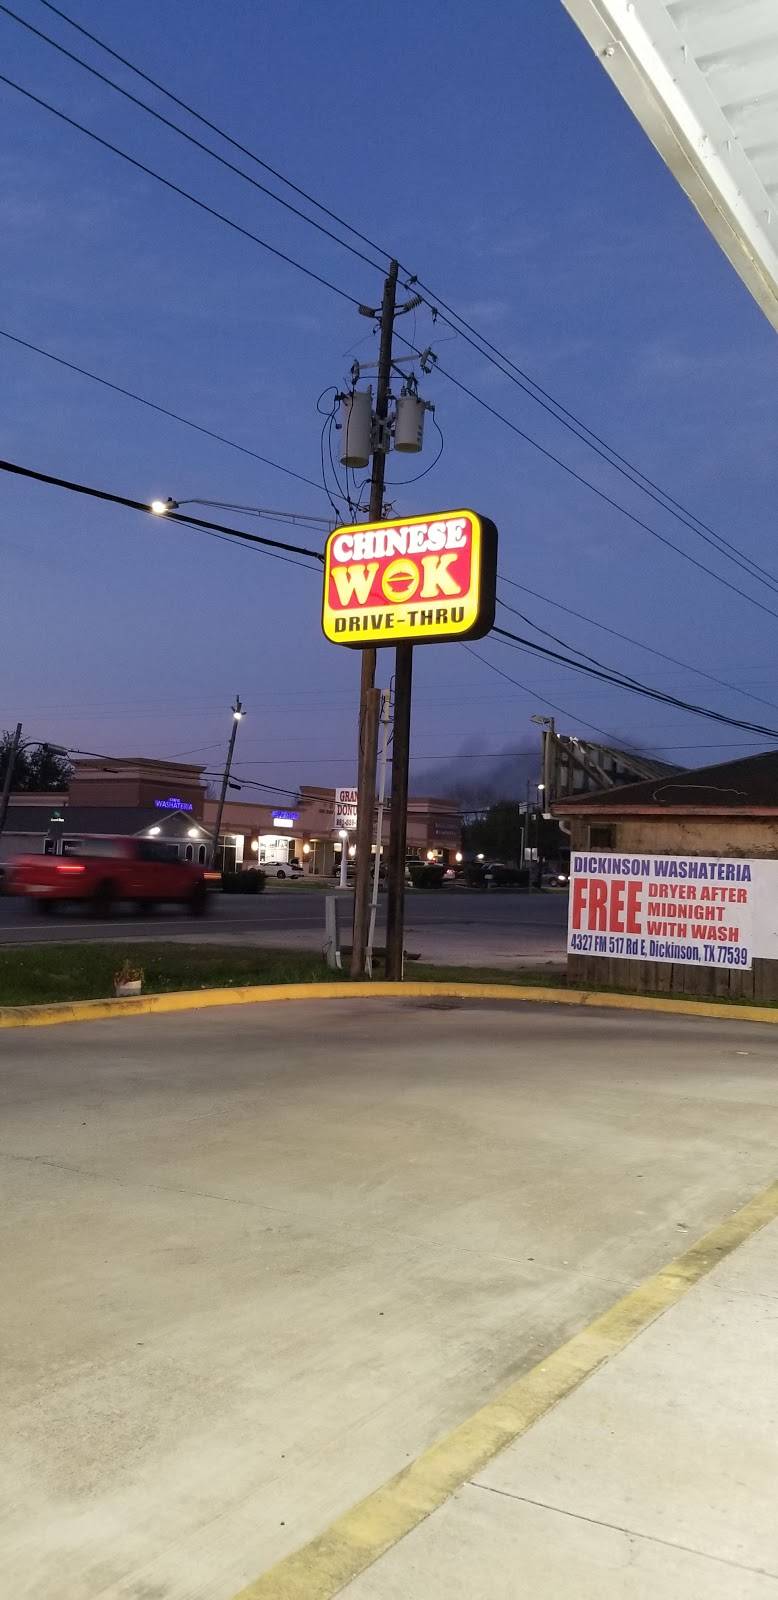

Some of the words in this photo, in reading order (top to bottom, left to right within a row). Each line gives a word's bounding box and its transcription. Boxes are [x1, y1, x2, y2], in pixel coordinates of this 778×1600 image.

[333, 518, 467, 563] CHINESE
[331, 553, 461, 607] WOK
[335, 606, 465, 633] DRIVE-THRU
[573, 856, 650, 877] DICKINSON
[654, 859, 751, 882] WASHATERIA
[572, 877, 643, 935] FREE
[648, 883, 697, 900] DRYER
[700, 886, 748, 903] AFTER
[647, 902, 726, 922] MIDNIGHT
[646, 920, 687, 938] WITH
[691, 924, 739, 943] WASH
[570, 933, 593, 951] 4327
[594, 935, 607, 953] FM
[608, 937, 625, 954] 517
[626, 938, 638, 955] Rd
[640, 939, 648, 958] E,
[649, 940, 702, 962] Dickinson,
[703, 944, 716, 963] TX
[717, 945, 748, 966] 77539
